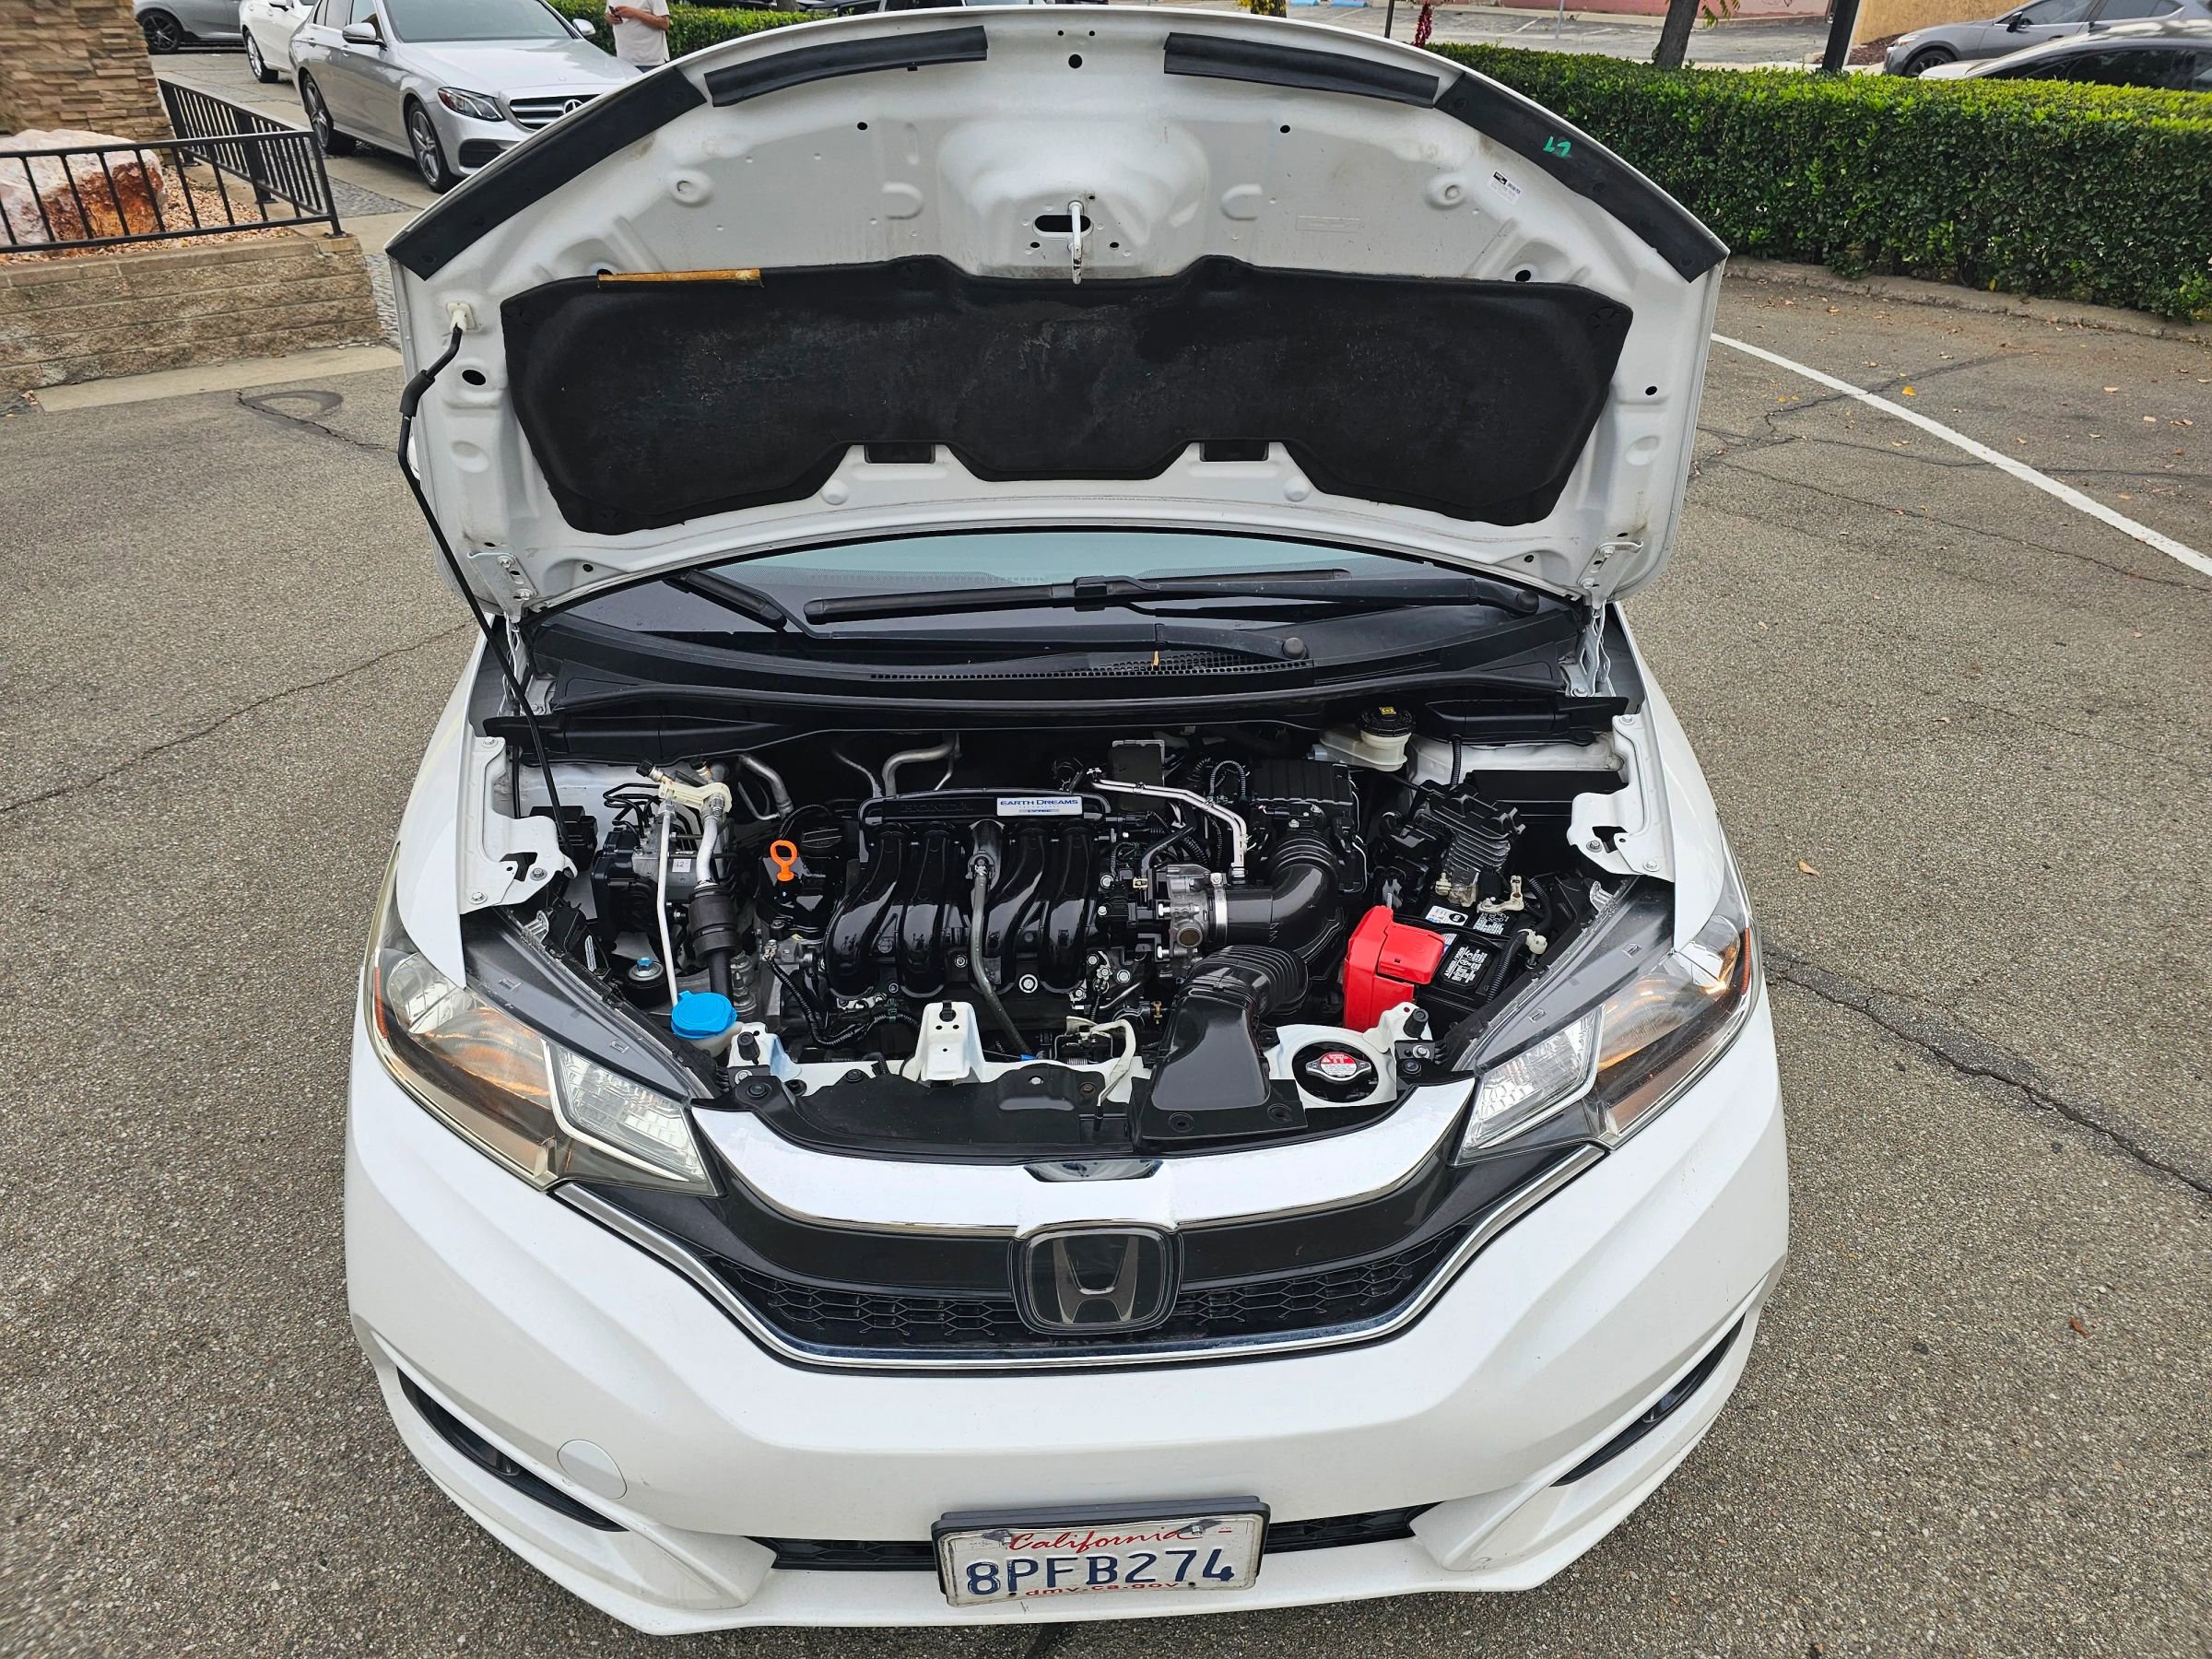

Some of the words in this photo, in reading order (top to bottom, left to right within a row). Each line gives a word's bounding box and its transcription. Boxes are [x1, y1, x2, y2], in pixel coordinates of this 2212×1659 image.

[1008, 1528, 1196, 1554] California
[965, 1548, 1235, 1596] 8PFB274
[1026, 1582, 1180, 1597] dmv.ca.gov
